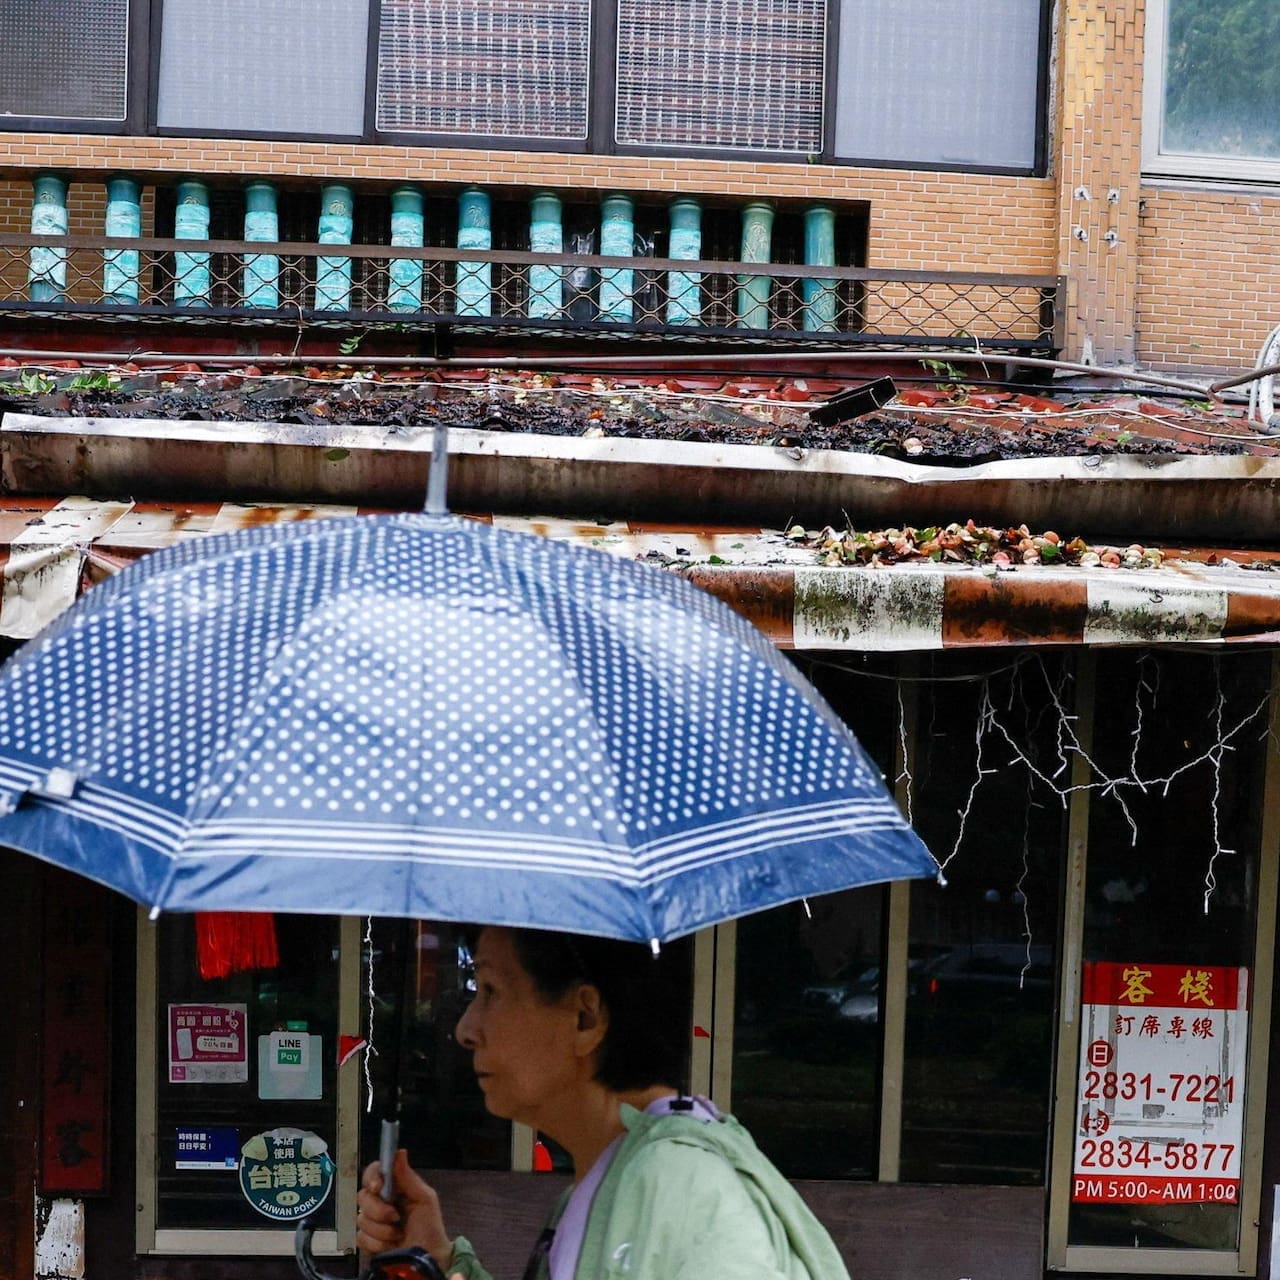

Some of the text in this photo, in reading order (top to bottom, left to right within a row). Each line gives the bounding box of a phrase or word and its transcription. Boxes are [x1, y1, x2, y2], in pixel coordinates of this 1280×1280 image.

[1118, 967, 1215, 1007] 客棧
[278, 1039, 301, 1048] LINE
[280, 1052, 299, 1062] Pay
[1084, 1071, 1234, 1103] 2831-7221
[273, 1148, 295, 1159] 使用
[1081, 1140, 1235, 1171] 2834-5877
[248, 1162, 322, 1190] 台灣豬
[1074, 1181, 1103, 1198] PM
[258, 1196, 318, 1216] TAIWAN PORK
